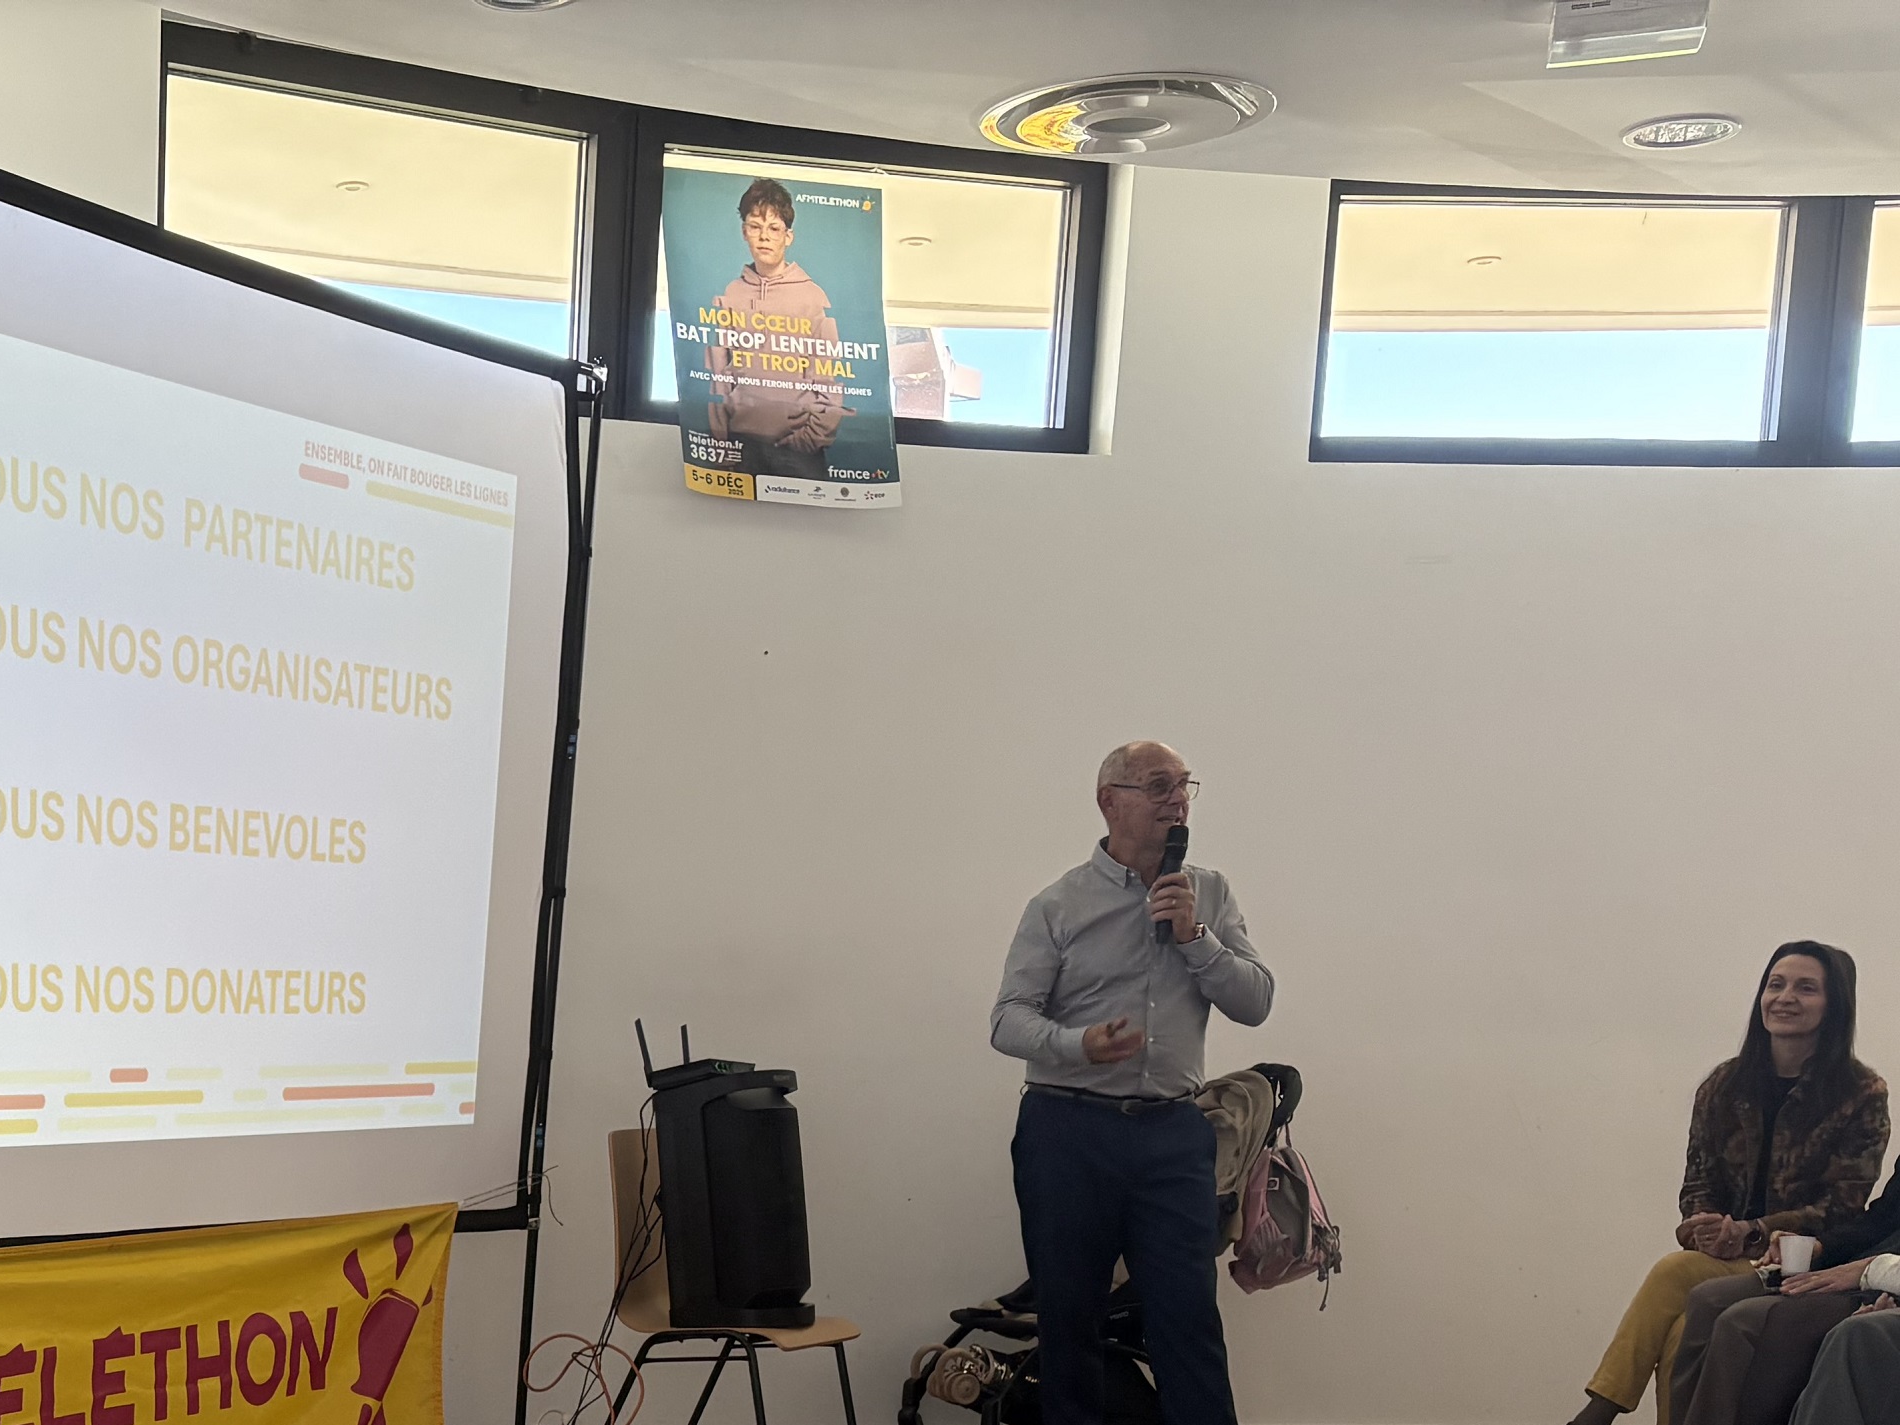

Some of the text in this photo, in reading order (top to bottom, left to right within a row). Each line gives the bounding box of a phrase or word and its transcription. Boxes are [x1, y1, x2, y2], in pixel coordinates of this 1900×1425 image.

[699, 307, 812, 335] MON CŒUR
[676, 322, 880, 361] BAT TROP LENTEMENT
[690, 370, 710, 381] AVEC
[738, 377, 761, 387] NOUS
[763, 380, 794, 390] FERONS
[795, 382, 828, 393] BOUGER
[829, 385, 843, 395] LES
[844, 387, 872, 397] LIGNES
[733, 351, 855, 378] ET TROP MAL
[690, 444, 725, 463] 3637
[304, 440, 509, 507] ENSEMBLE, ON FAIT BOUGER LES LIGNES
[692, 469, 743, 489] 5-6 DÉC
[80, 473, 164, 541] NOS
[184, 497, 415, 592] PARTENAIRES
[79, 616, 162, 678] NOS
[172, 635, 452, 721] ORGANISATEURS
[77, 793, 158, 849] NOS
[169, 803, 367, 864] BENEVOLES
[75, 965, 155, 1014] NOS
[165, 967, 367, 1015] DONATEURS
